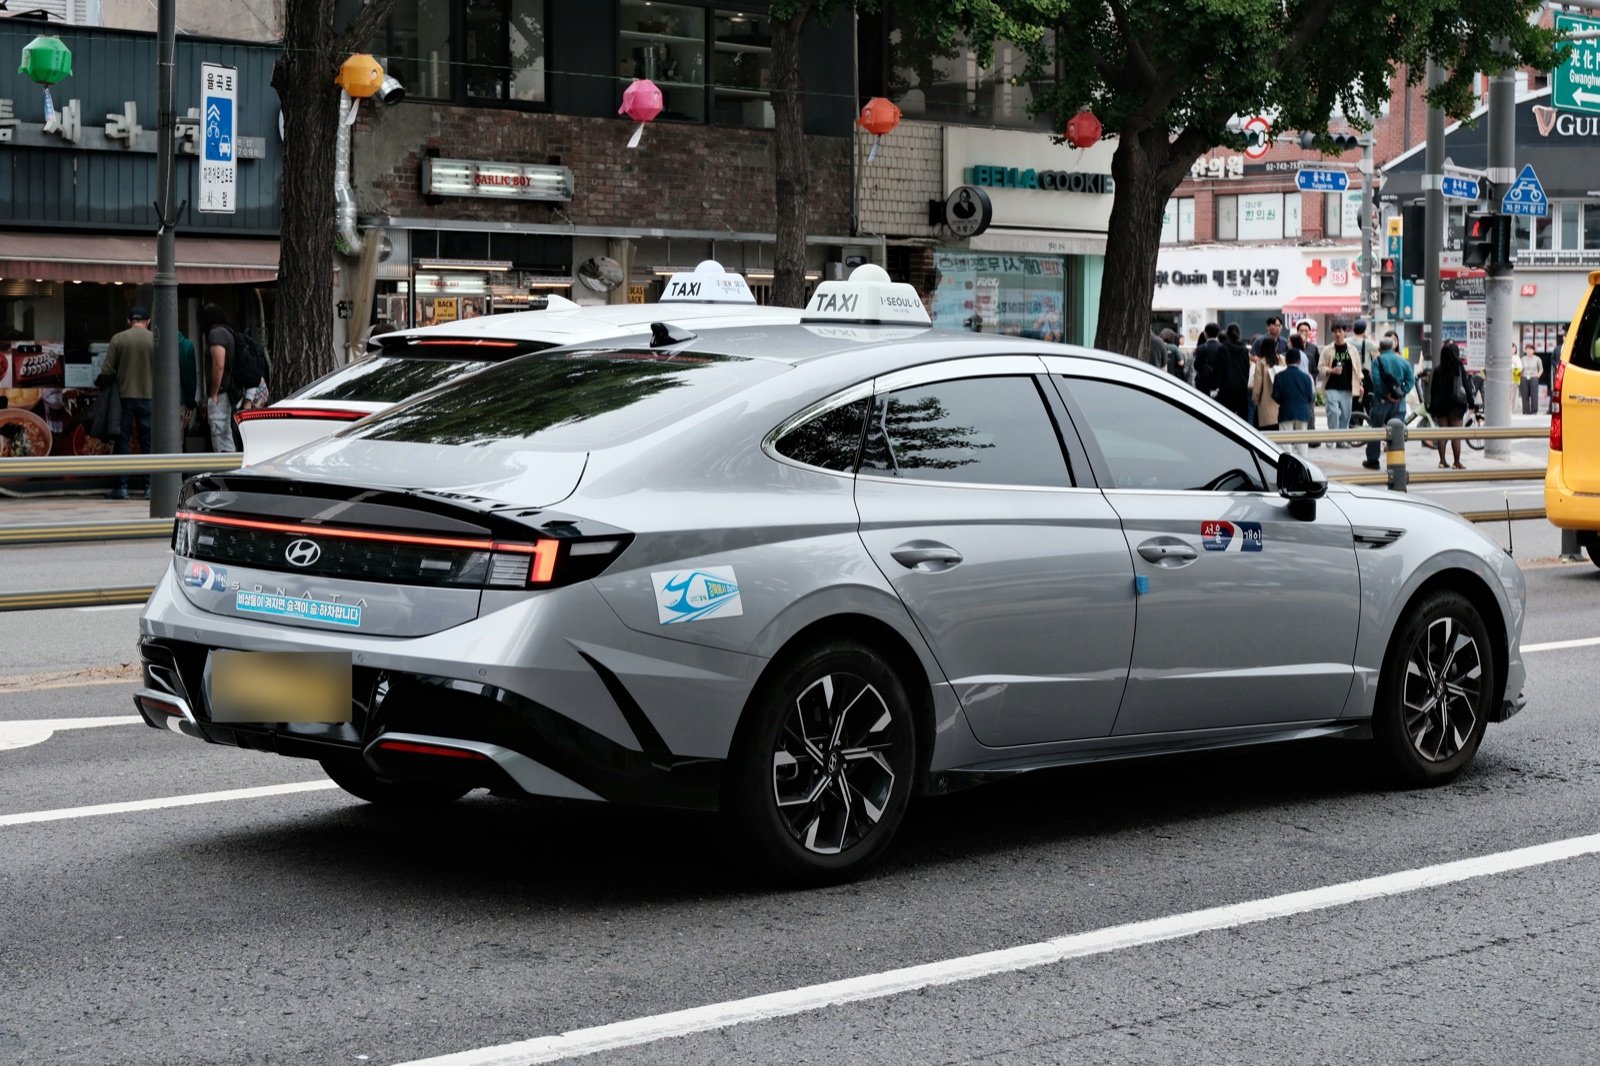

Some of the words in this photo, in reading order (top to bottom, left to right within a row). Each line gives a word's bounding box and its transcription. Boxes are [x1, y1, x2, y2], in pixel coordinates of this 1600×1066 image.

[974, 165, 1039, 190] BELLA
[1190, 155, 1244, 182] 한의원
[474, 173, 510, 187] GARLIC
[512, 175, 532, 187] BOY
[1244, 209, 1276, 221] 한의원
[1505, 202, 1545, 214] 자전거횡단
[671, 282, 702, 297] TAXI
[437, 300, 454, 308] BACK
[817, 293, 859, 312] TAXI
[1204, 523, 1222, 544] 서울
[1243, 528, 1263, 547] 개인
[231, 580, 368, 608] SONATA
[238, 592, 264, 608] 비상등이
[264, 596, 286, 611] 켜지면
[287, 599, 309, 614] 승객이
